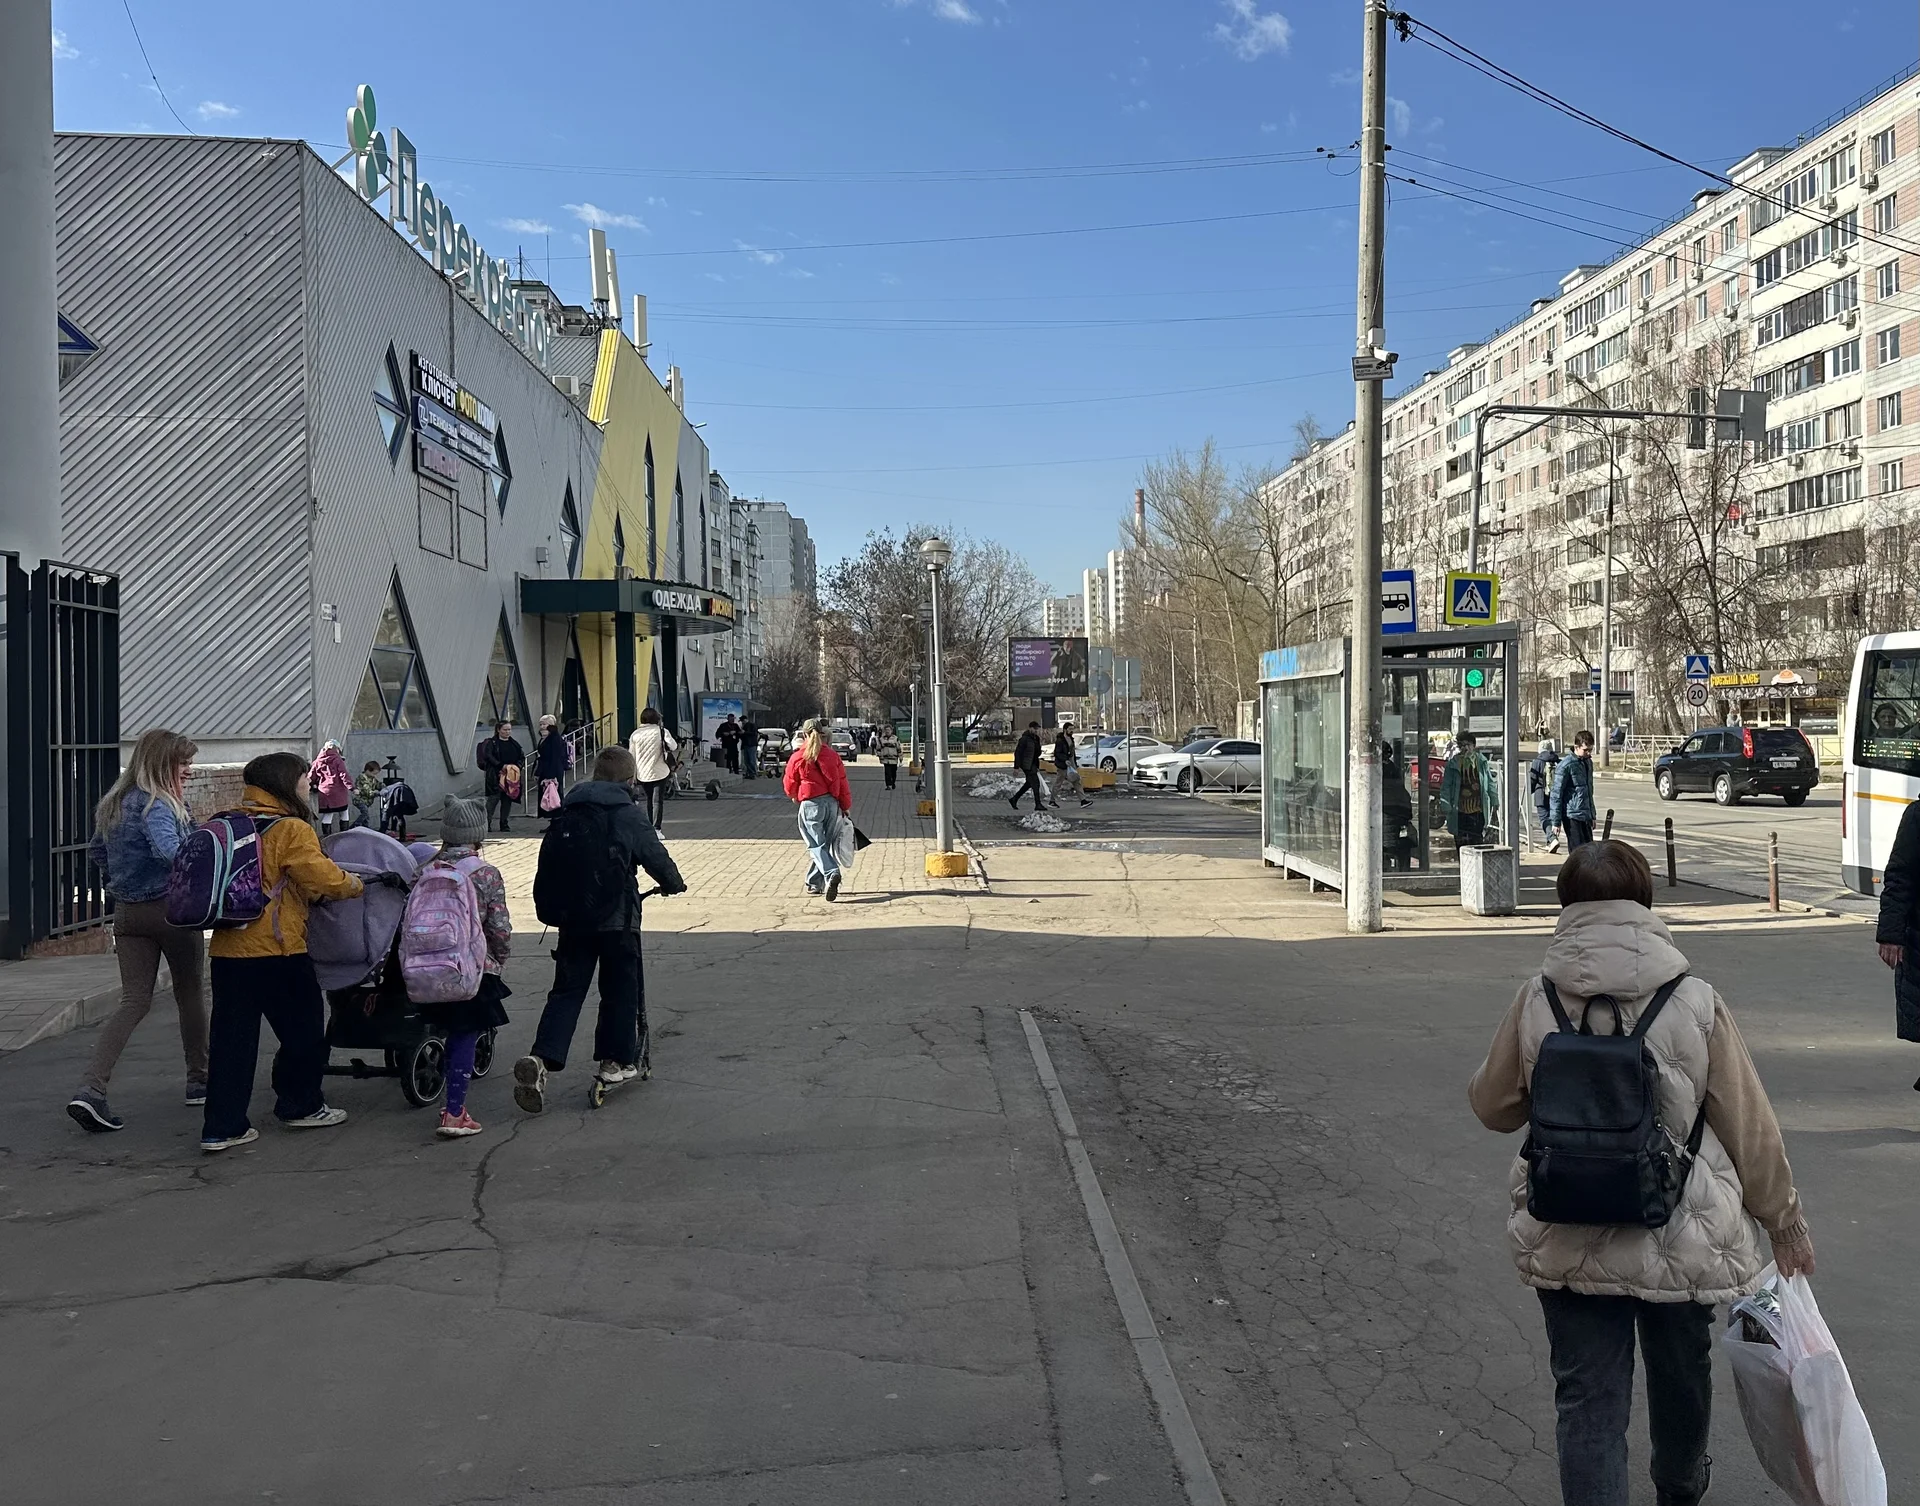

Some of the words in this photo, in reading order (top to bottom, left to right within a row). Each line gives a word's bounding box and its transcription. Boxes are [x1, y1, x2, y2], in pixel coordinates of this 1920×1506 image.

[418, 355, 458, 393] ИЗГОТОВЛЕНИЕ
[652, 589, 702, 614] ОДЕЖДА
[1691, 689, 1703, 700] 20
